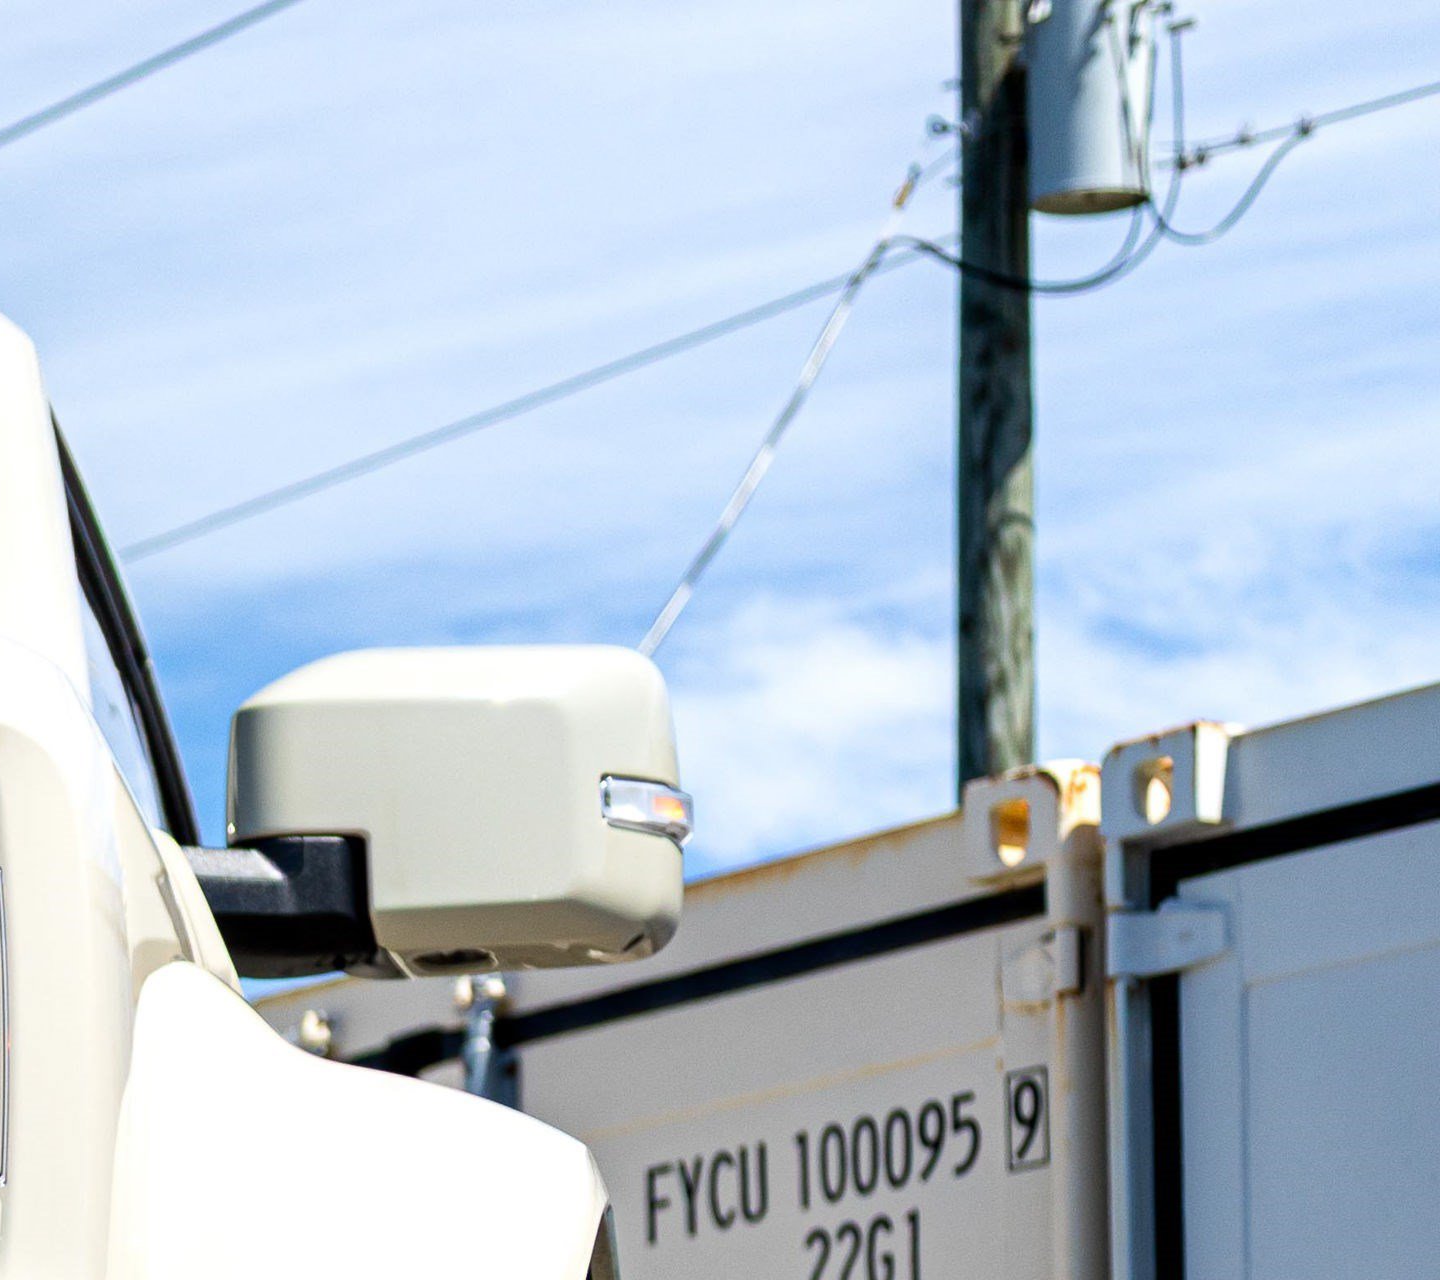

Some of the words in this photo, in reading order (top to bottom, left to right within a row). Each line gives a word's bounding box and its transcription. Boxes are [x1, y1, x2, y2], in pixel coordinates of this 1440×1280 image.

[645, 1140, 769, 1247] FYCU
[794, 1090, 981, 1211] 100095
[1013, 1074, 1045, 1161] 9
